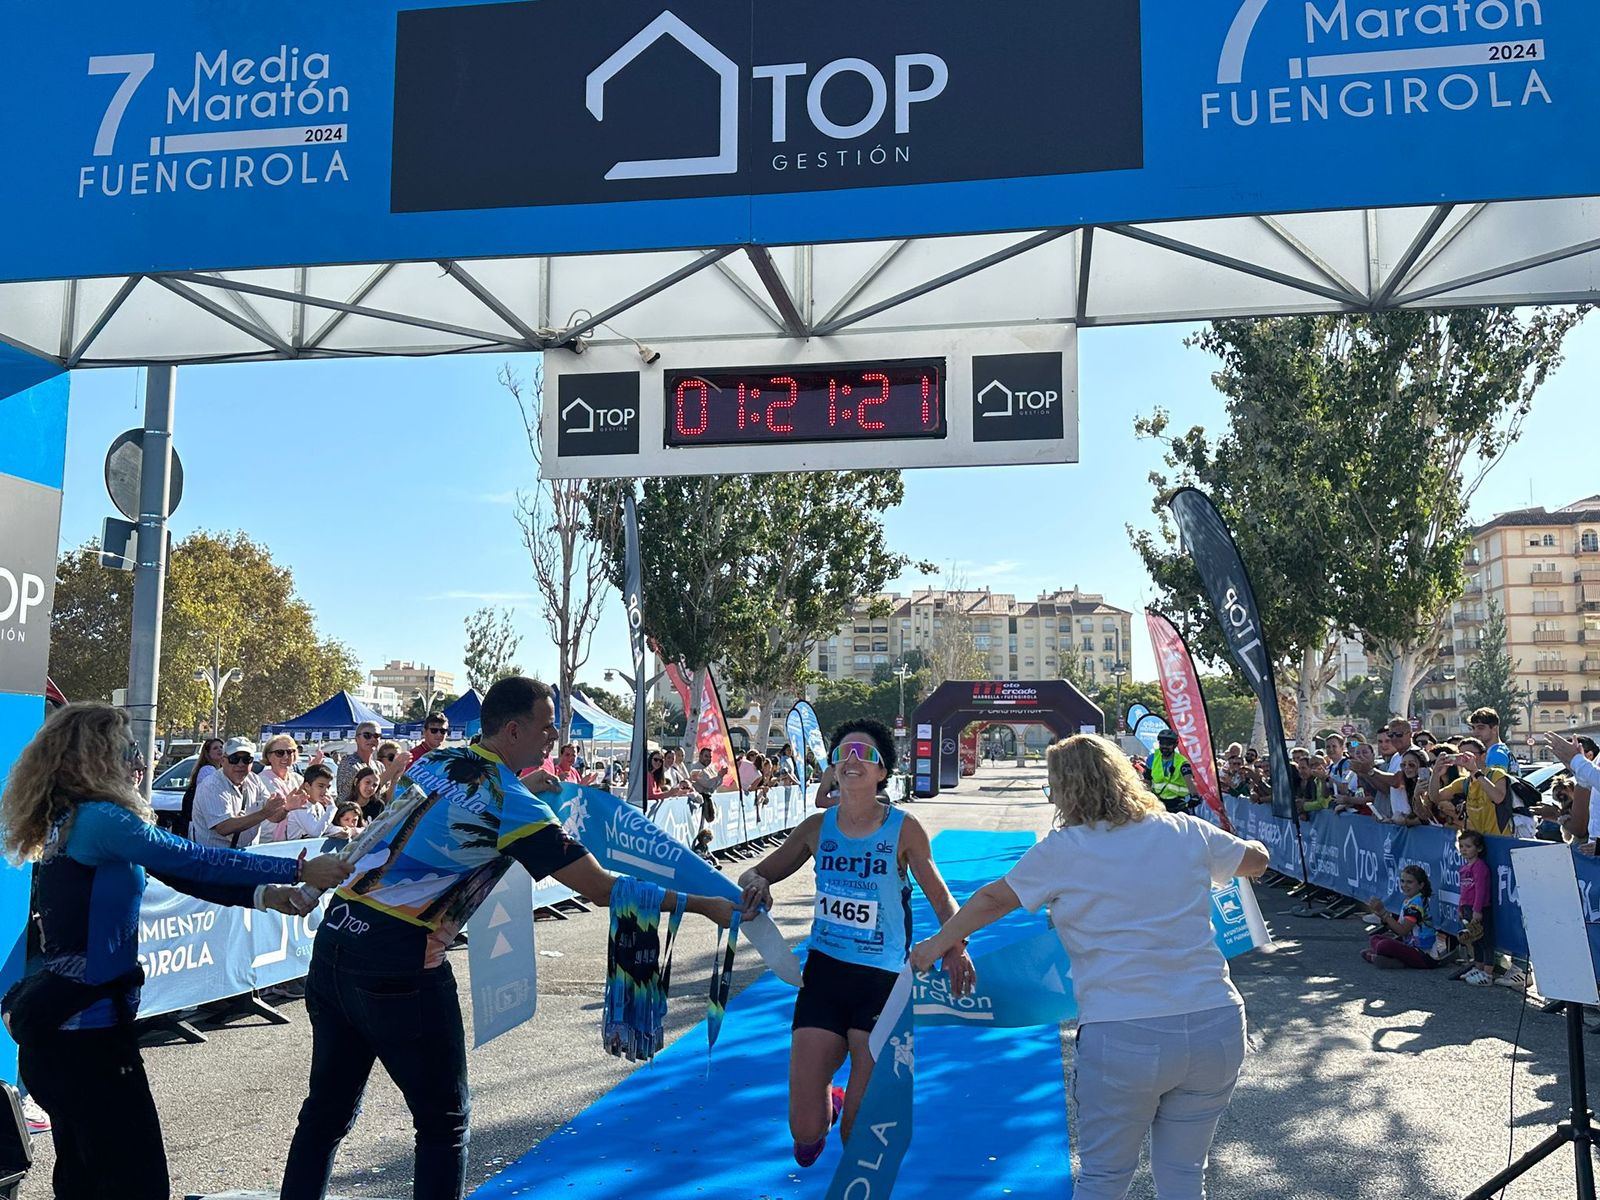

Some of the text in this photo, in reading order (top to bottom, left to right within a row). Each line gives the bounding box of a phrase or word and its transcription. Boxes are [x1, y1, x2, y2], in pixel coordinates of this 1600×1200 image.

[195, 45, 330, 87] Media
[1488, 43, 1537, 61] 2024
[88, 53, 155, 156] 7
[167, 80, 349, 124] Maratón
[752, 53, 949, 143] TOP
[1202, 69, 1552, 128] FUENGIROLA
[304, 127, 343, 143] 2024
[79, 150, 349, 198] FUENGIROLA
[772, 144, 910, 171] GESTIÓN
[596, 408, 636, 427] TOP
[676, 373, 932, 436] 01:21:21
[1014, 390, 1058, 410] TOP
[404, 757, 487, 815] Fuengirola
[605, 821, 683, 862] Maratón
[820, 852, 889, 879] nerja
[1360, 849, 1379, 883] TOP
[344, 915, 370, 935] TOP
[820, 897, 870, 923] 1465
